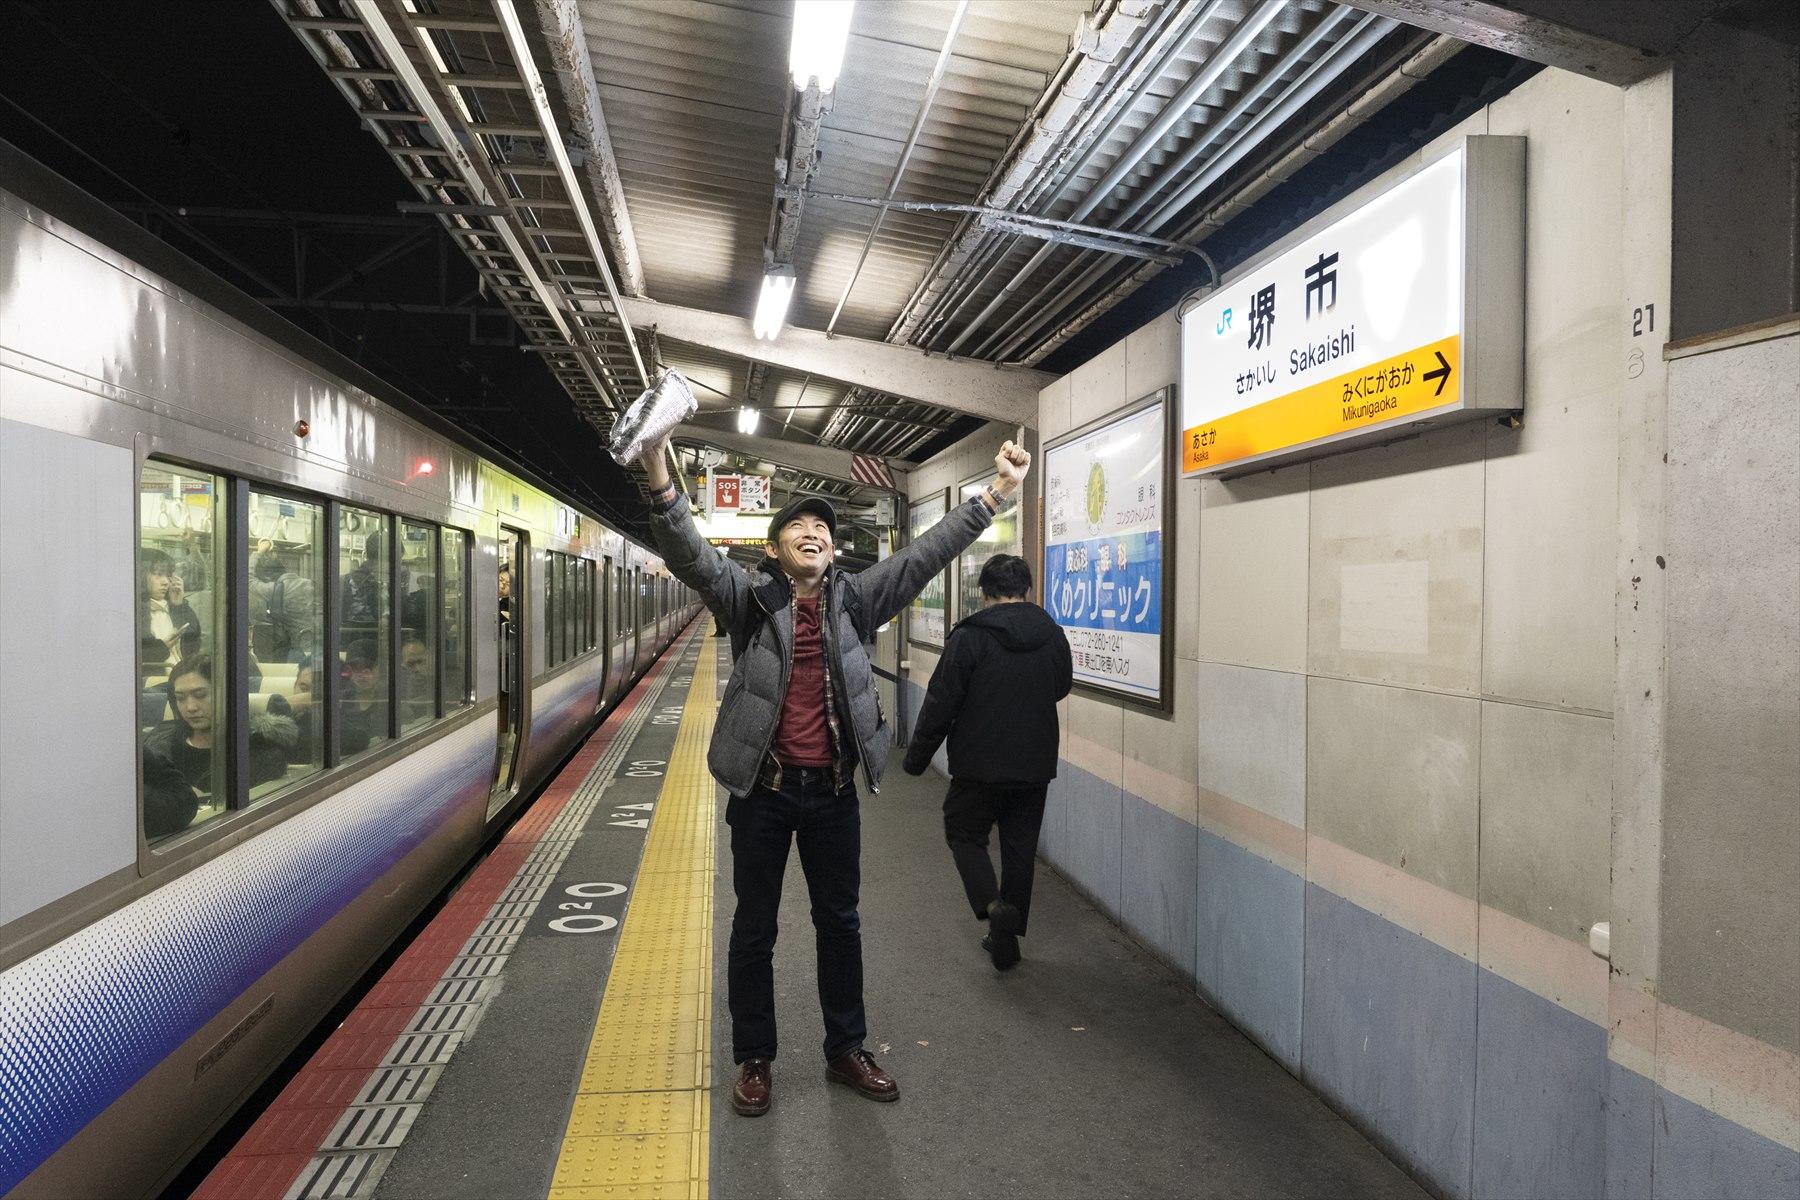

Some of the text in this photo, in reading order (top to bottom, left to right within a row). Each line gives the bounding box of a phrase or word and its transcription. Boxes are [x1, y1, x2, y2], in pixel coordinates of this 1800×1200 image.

[1248, 251, 1339, 351] 堺市
[1217, 307, 1232, 335] JR
[1633, 303, 1655, 337] 21
[1289, 325, 1355, 375] Sakaishi
[1236, 361, 1277, 395] さかいし
[1342, 361, 1416, 403] みくにがおか
[1342, 395, 1398, 422] Mikunigaoka
[1192, 427, 1217, 449] あさか
[1192, 450, 1209, 464] Asaka
[718, 482, 737, 490] SOS
[1051, 574, 1151, 624] くめクリニック
